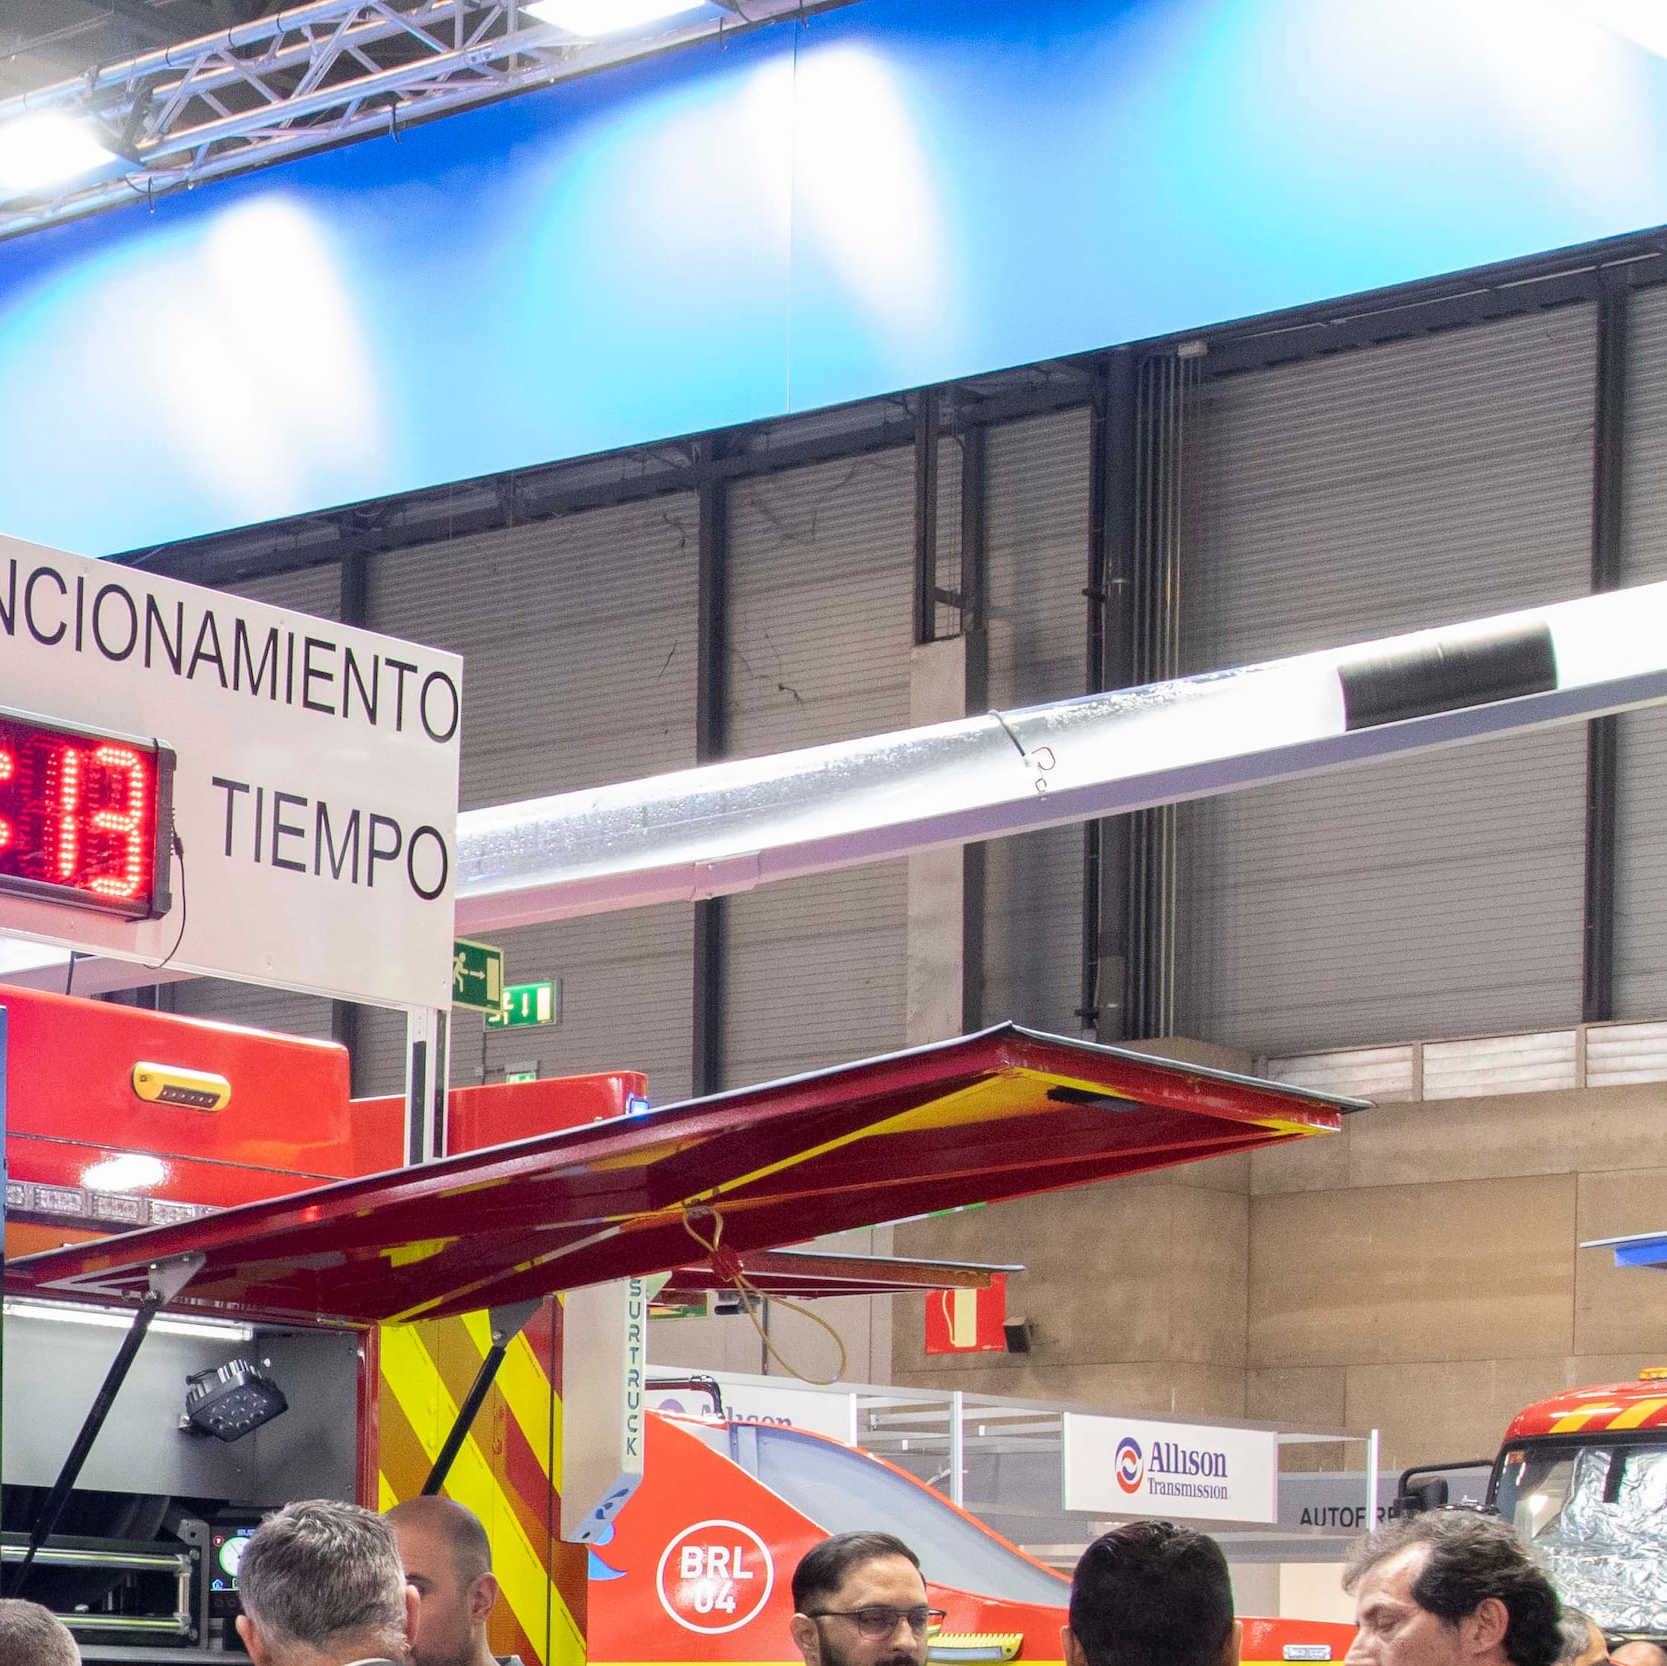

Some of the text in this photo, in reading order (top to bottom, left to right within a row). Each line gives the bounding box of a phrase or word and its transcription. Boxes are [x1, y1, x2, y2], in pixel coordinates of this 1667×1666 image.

[212, 776, 449, 902] TIEMPO
[626, 1279, 642, 1457] SURTRUCK
[1148, 1440, 1227, 1478] Allison
[1148, 1477, 1228, 1500] Transmission
[680, 1545, 753, 1578] BRL
